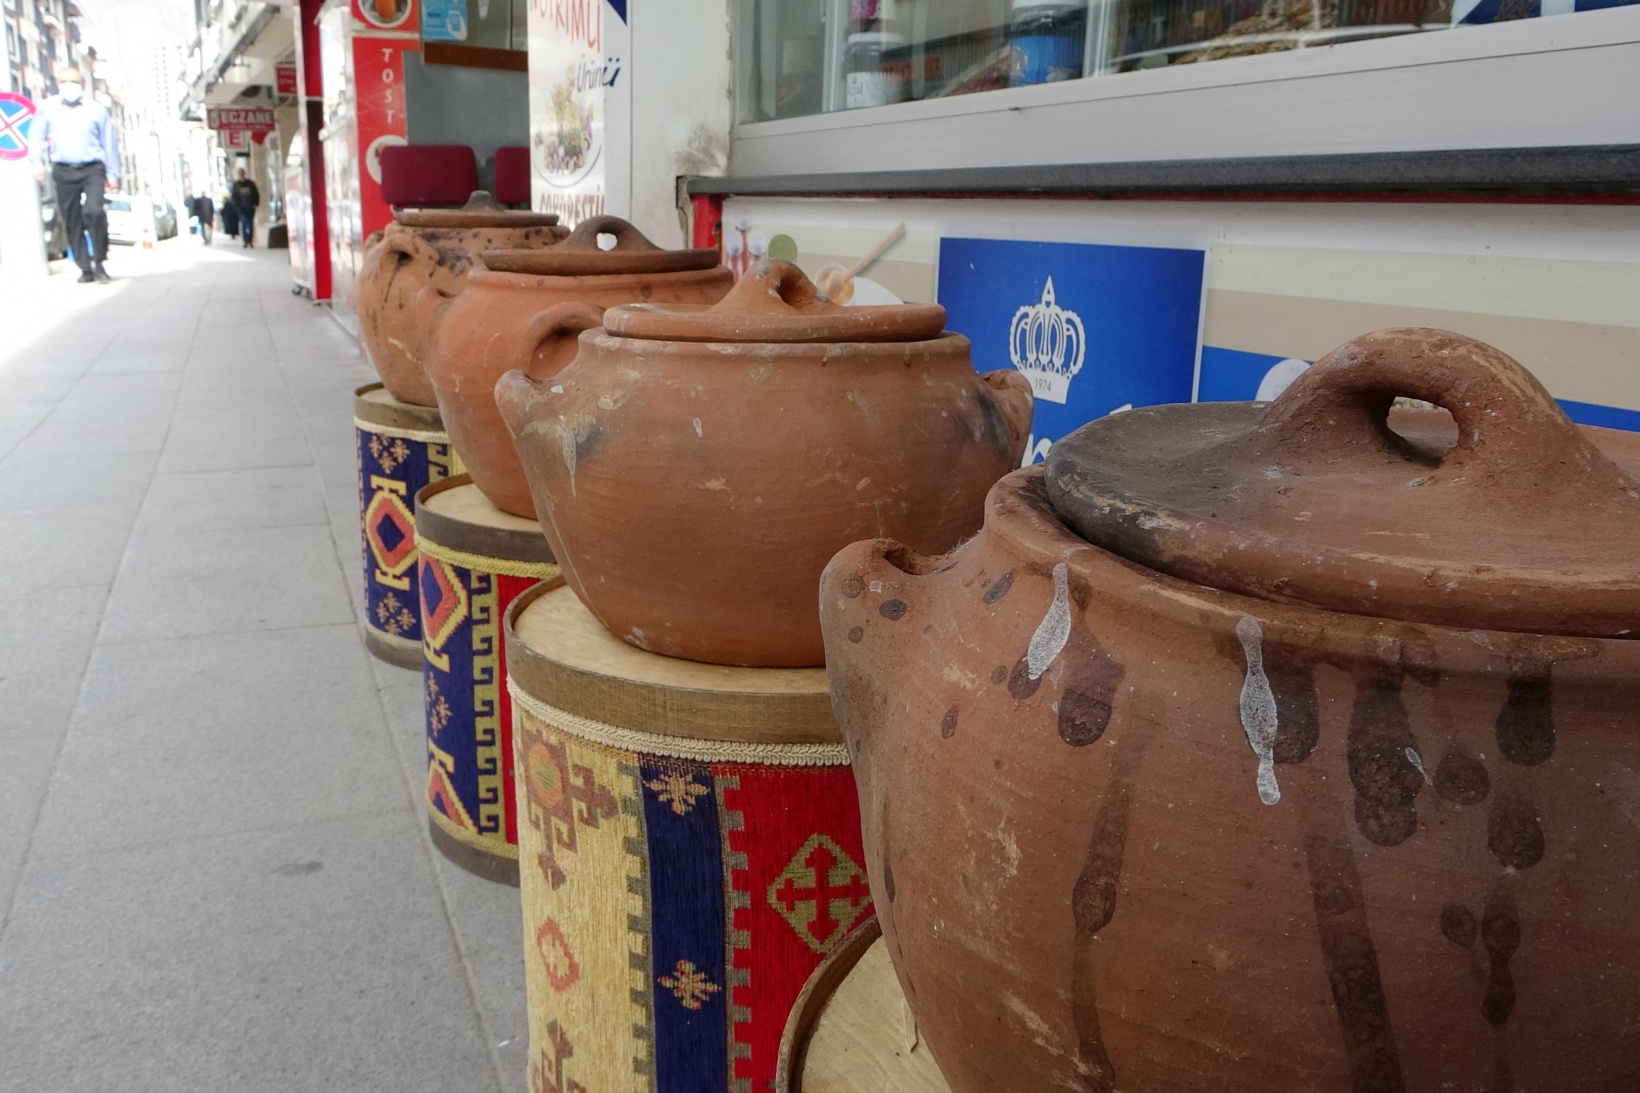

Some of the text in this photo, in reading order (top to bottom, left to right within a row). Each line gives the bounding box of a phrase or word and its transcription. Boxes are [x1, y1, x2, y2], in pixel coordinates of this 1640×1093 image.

[381, 48, 396, 125] TOST
[220, 110, 272, 124] ECZANE
[1035, 378, 1052, 392] 1974
